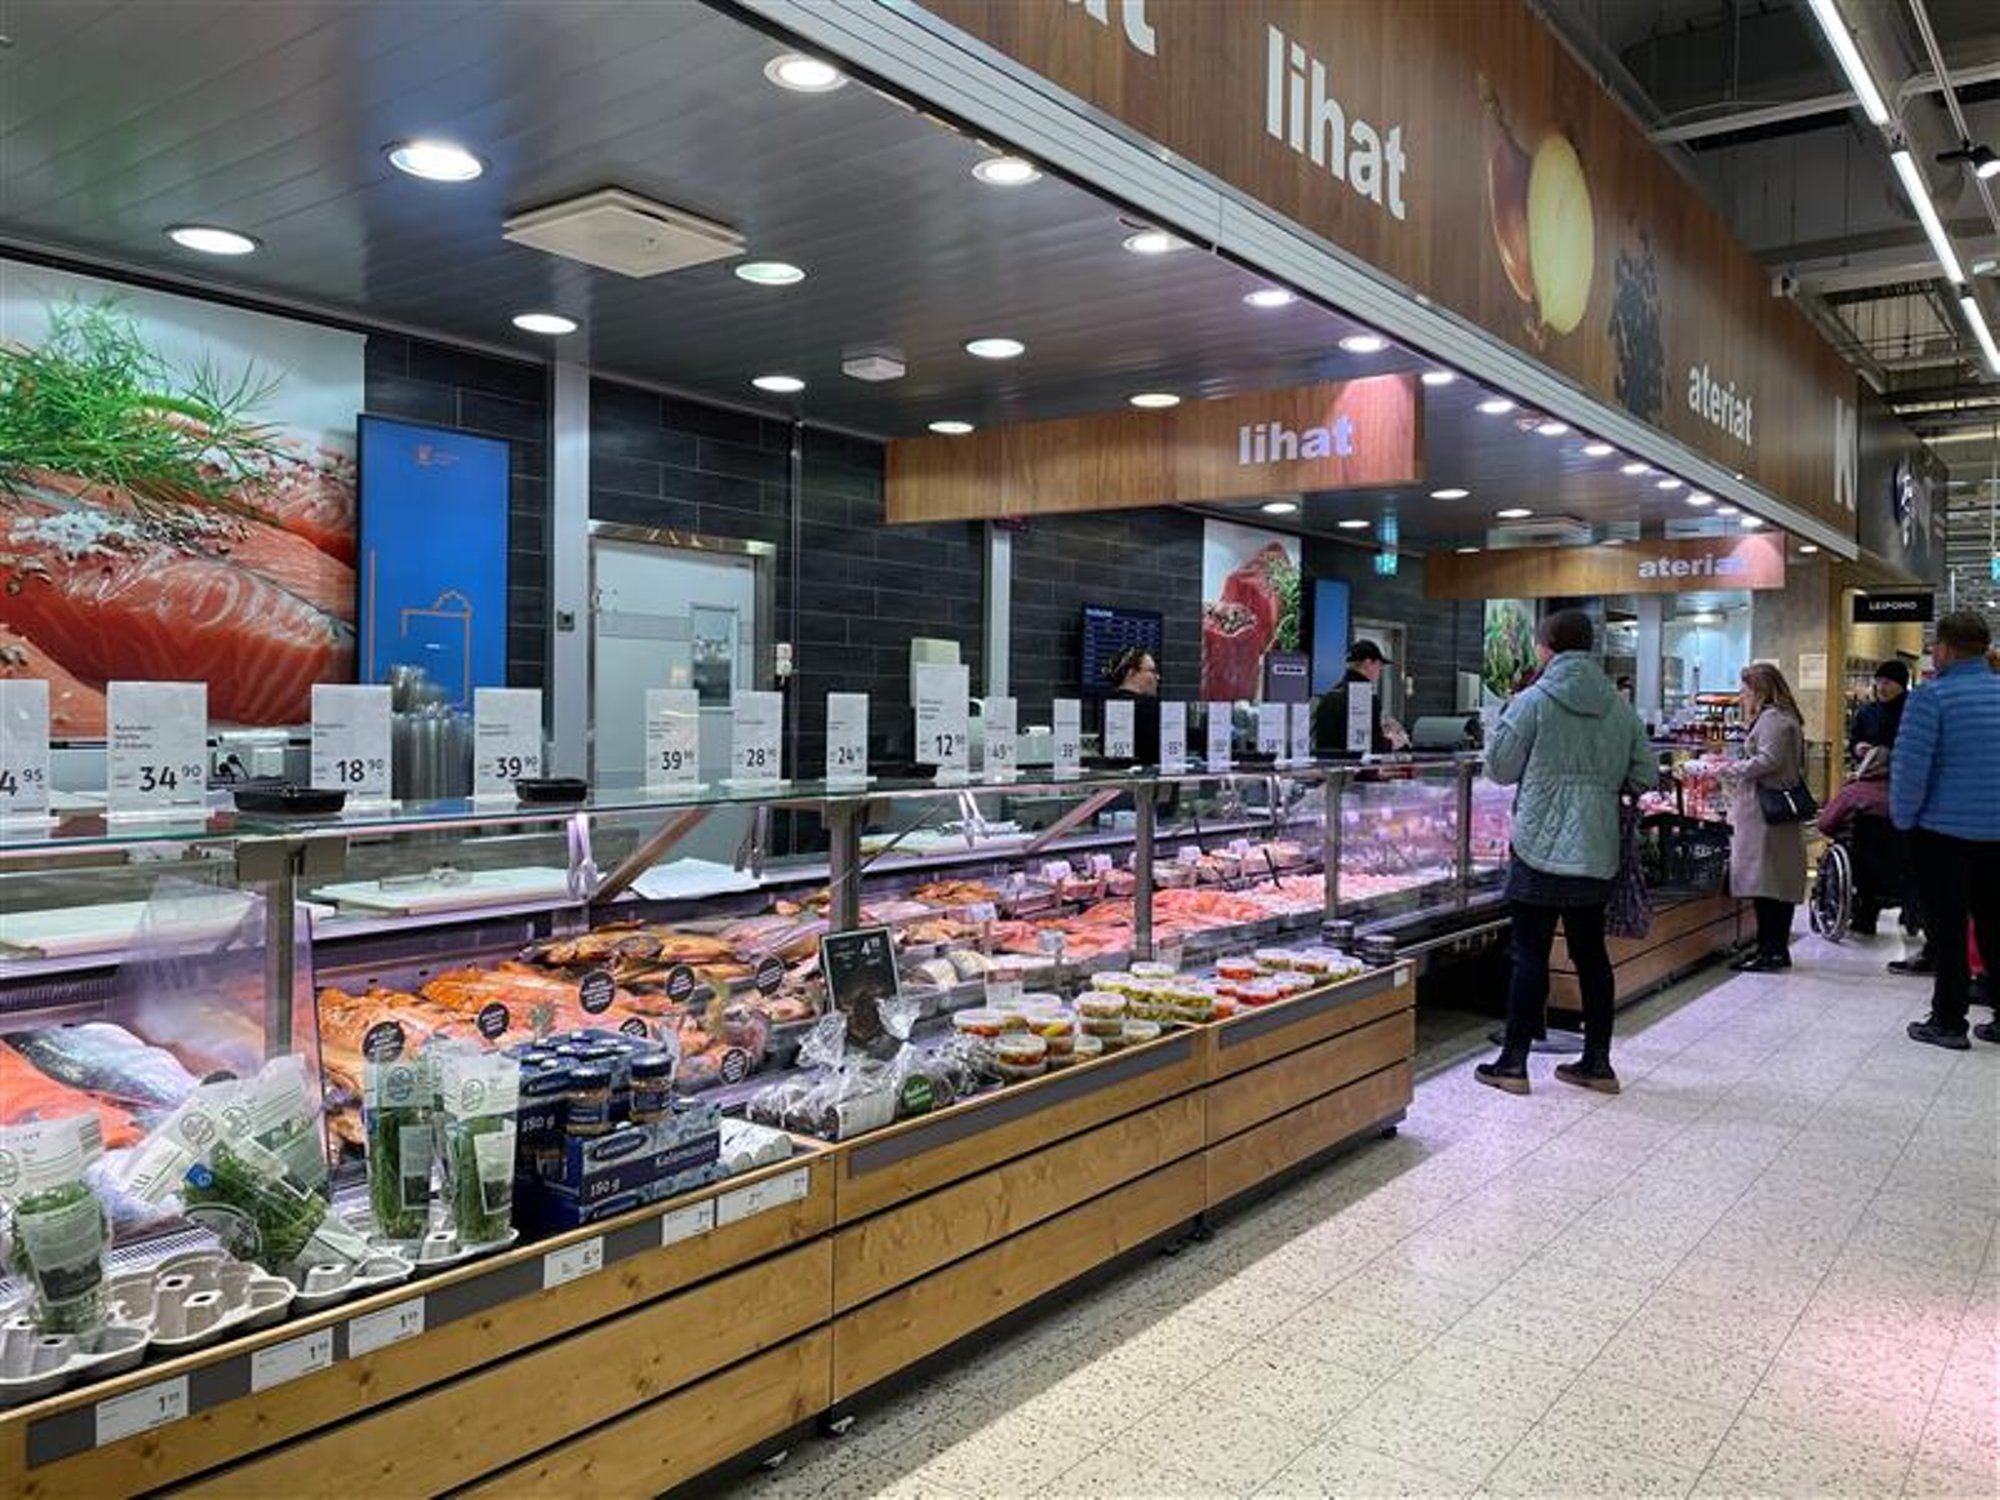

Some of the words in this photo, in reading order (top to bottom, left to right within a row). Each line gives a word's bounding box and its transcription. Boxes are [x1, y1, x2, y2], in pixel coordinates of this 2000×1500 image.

[1266, 24, 1406, 220] lihat
[1688, 364, 1753, 446] ateriat
[1238, 415, 1353, 465] lihat
[936, 733, 954, 756] 12
[495, 755, 522, 778] 39
[661, 750, 683, 770] 39
[746, 748, 766, 767] 28
[23, 768, 43, 783] 95
[139, 765, 178, 792] 34
[182, 764, 202, 778] 90
[337, 758, 366, 783] 18
